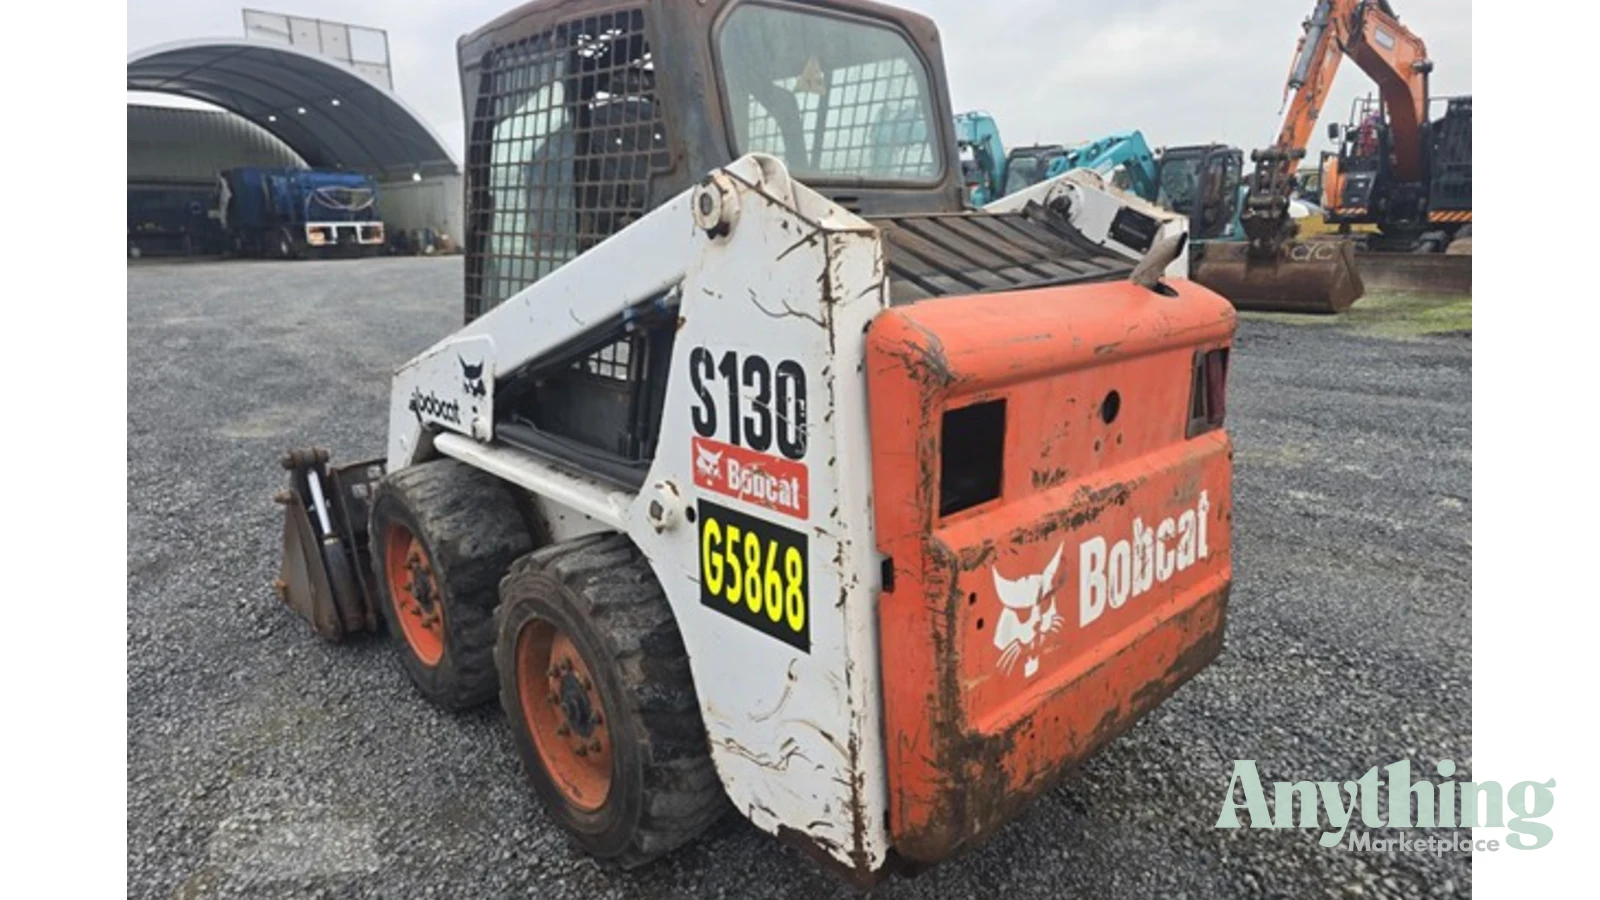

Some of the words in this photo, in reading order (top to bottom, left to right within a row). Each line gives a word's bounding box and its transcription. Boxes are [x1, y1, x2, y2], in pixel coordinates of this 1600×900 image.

[689, 346, 807, 460] S130
[727, 458, 801, 510] Bobcat
[702, 517, 805, 632] G5868
[1079, 490, 1210, 628] Bobcat
